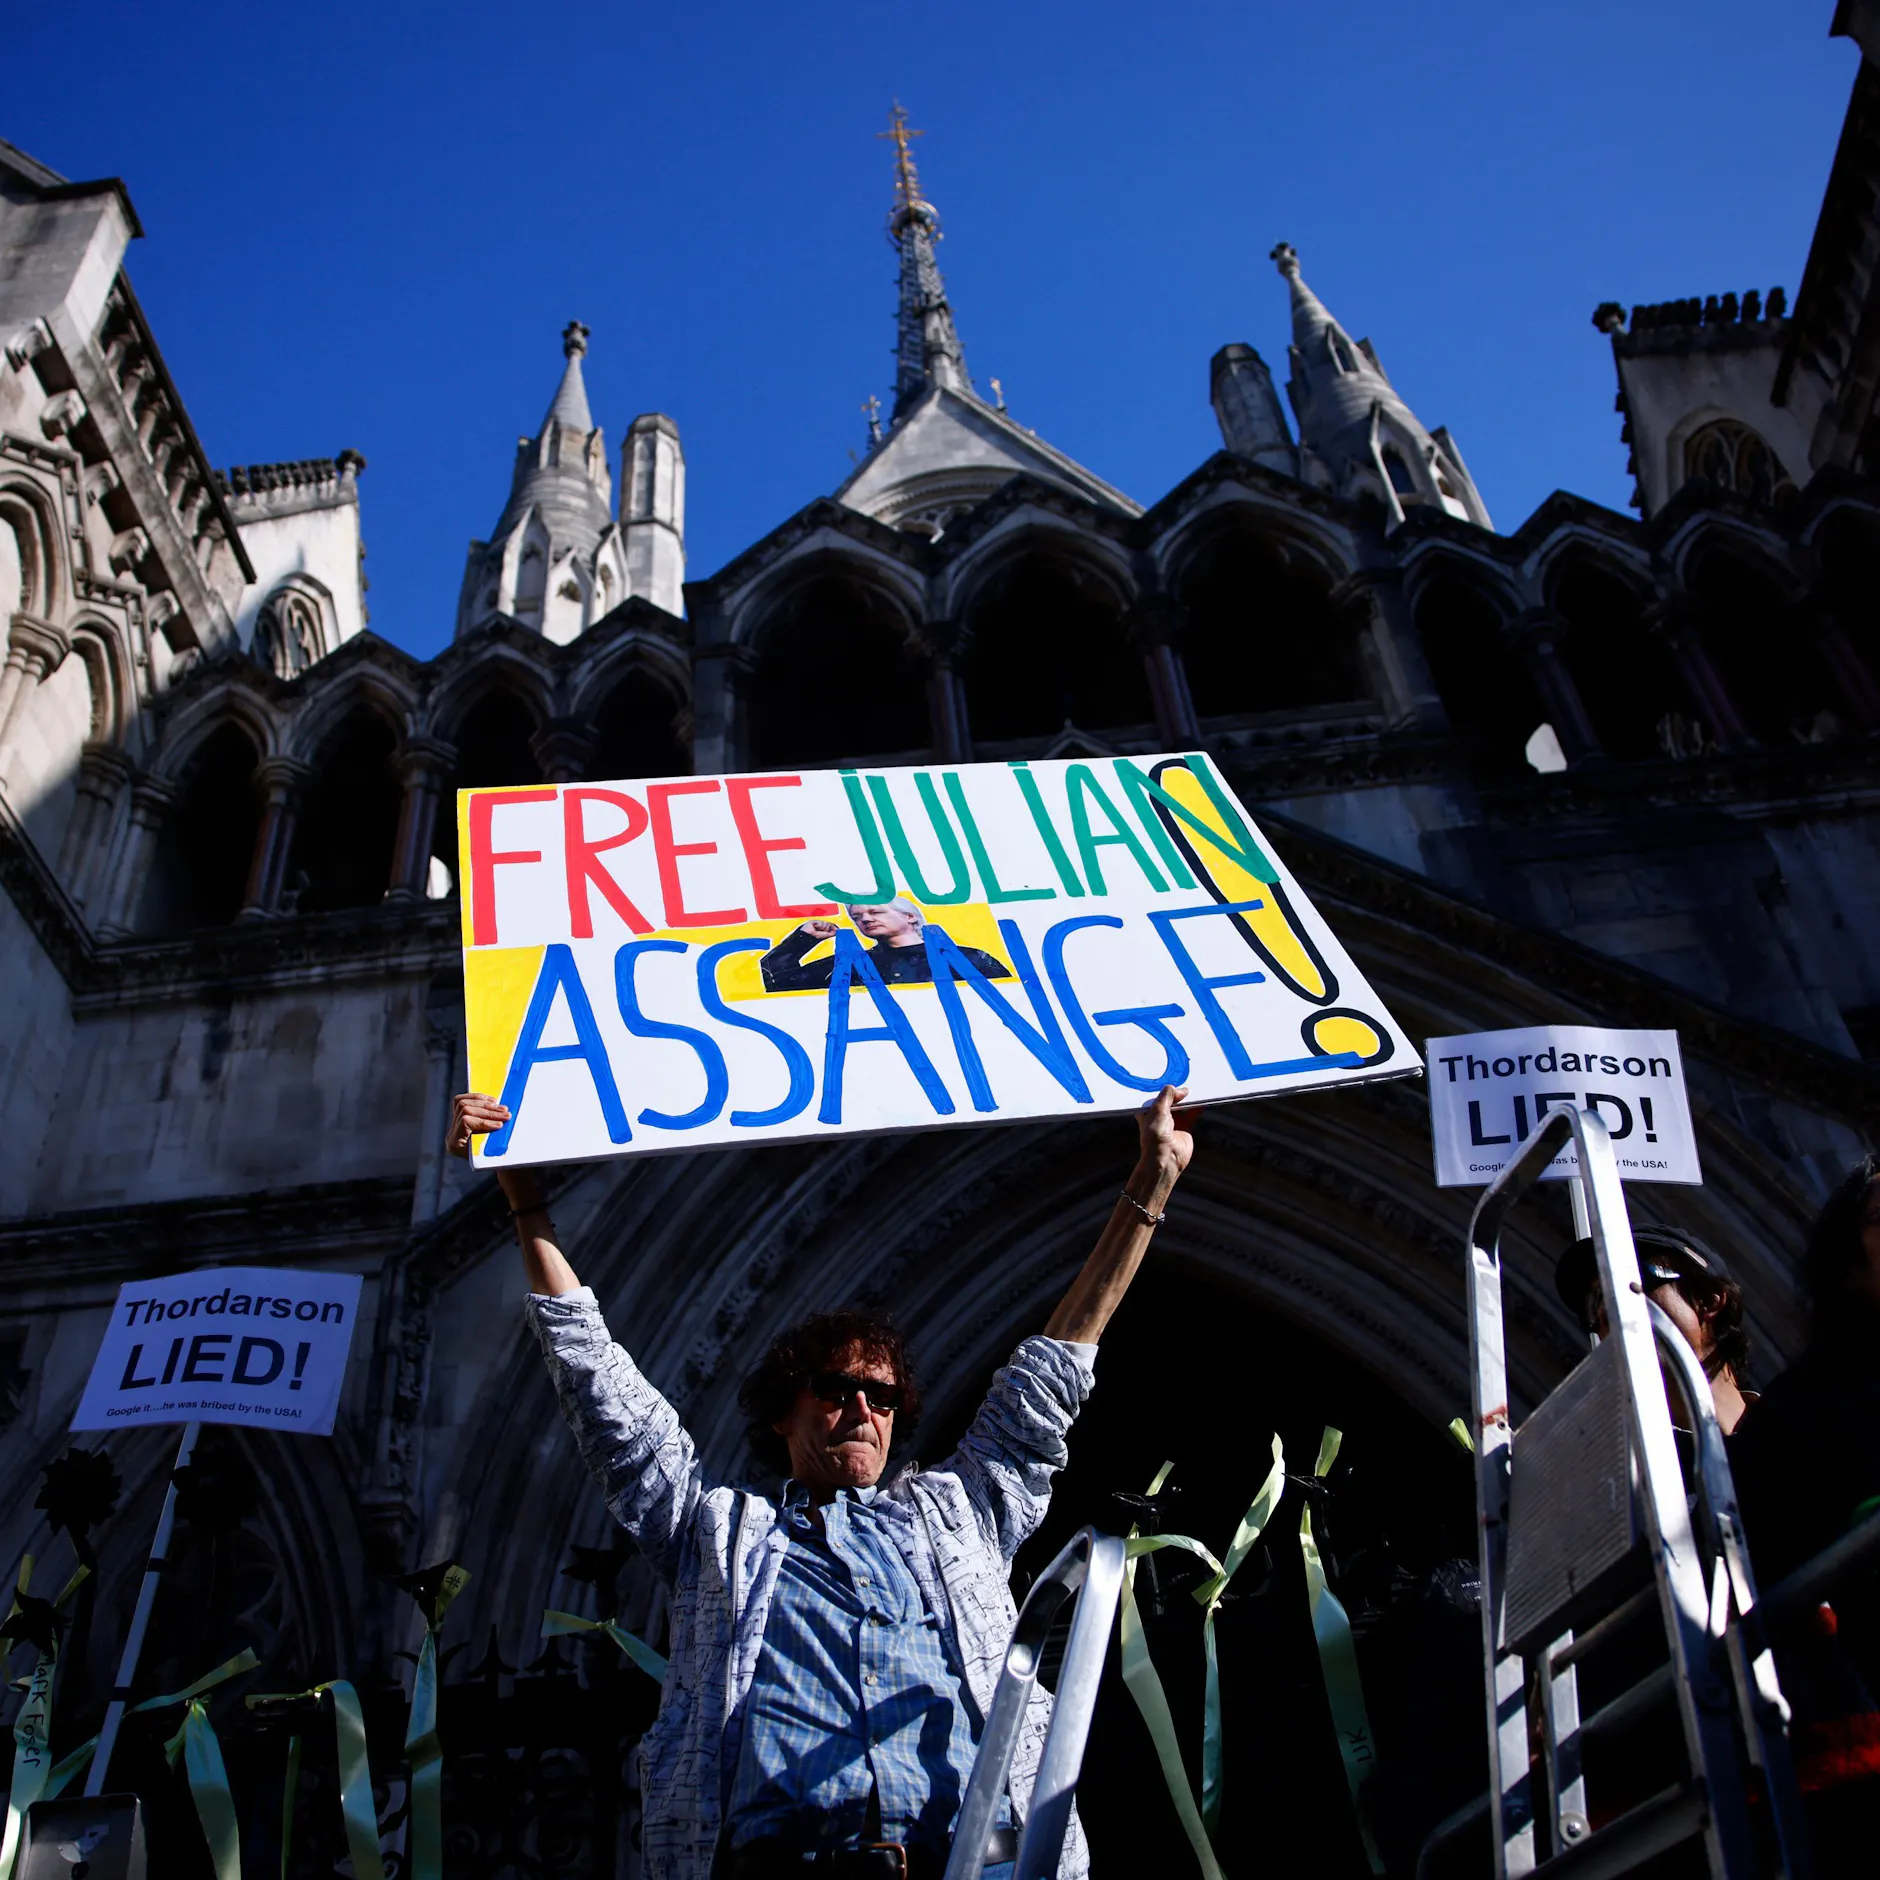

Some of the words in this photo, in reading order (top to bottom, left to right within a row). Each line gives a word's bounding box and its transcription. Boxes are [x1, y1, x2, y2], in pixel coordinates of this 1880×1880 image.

[469, 775, 839, 946] FREE
[1439, 1046, 1672, 1083] Thordarson
[1622, 1159, 1639, 1167] the
[1641, 1160, 1668, 1169] USA!
[124, 1288, 345, 1327] Thordarson
[118, 1334, 312, 1391] LIED!
[106, 1405, 141, 1417] Google
[177, 1400, 199, 1409] was
[200, 1400, 236, 1411] bribed
[238, 1403, 251, 1414] by
[254, 1404, 272, 1415] the
[274, 1408, 302, 1419] USA!
[1342, 1726, 1372, 1762] UK
